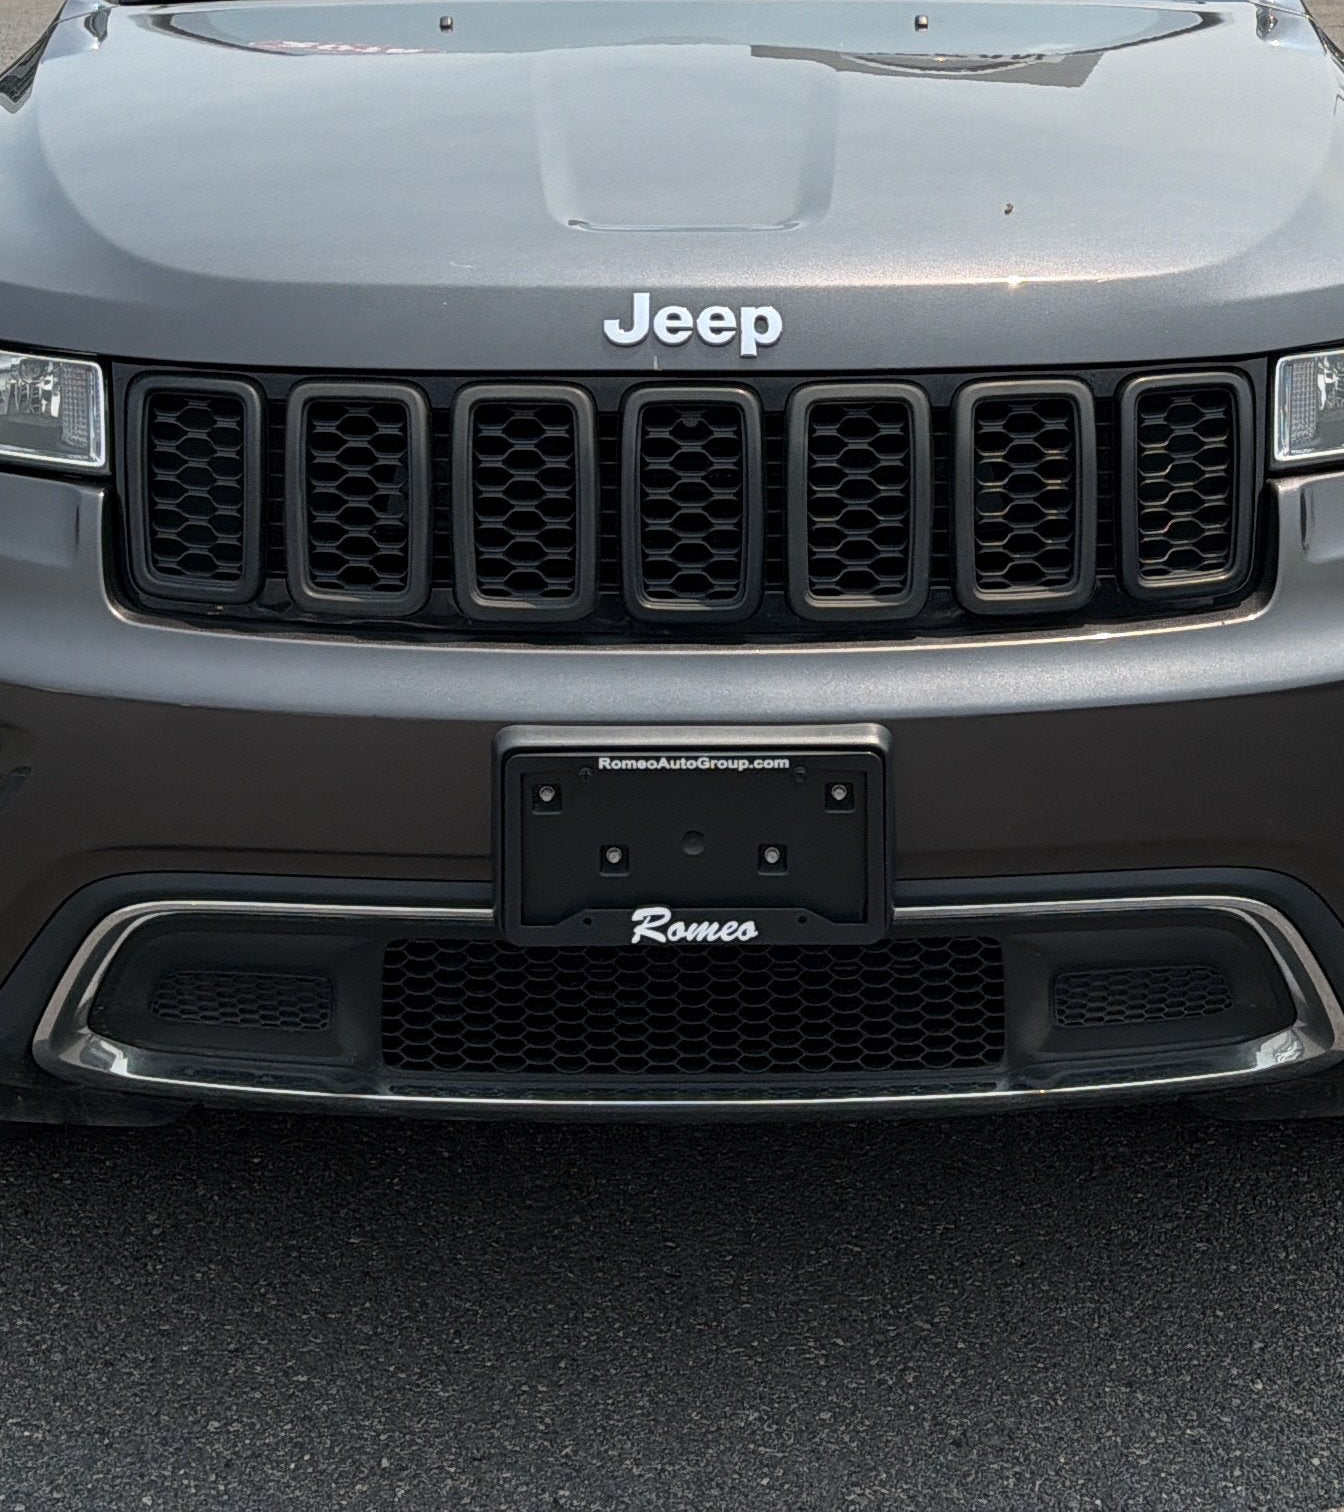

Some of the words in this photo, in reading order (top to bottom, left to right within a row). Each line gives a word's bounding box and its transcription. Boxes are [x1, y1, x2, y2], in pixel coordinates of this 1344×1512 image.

[603, 292, 783, 357] Jeep
[598, 757, 790, 771] RomeoAutoGroup.com
[631, 906, 759, 944] Romeo
